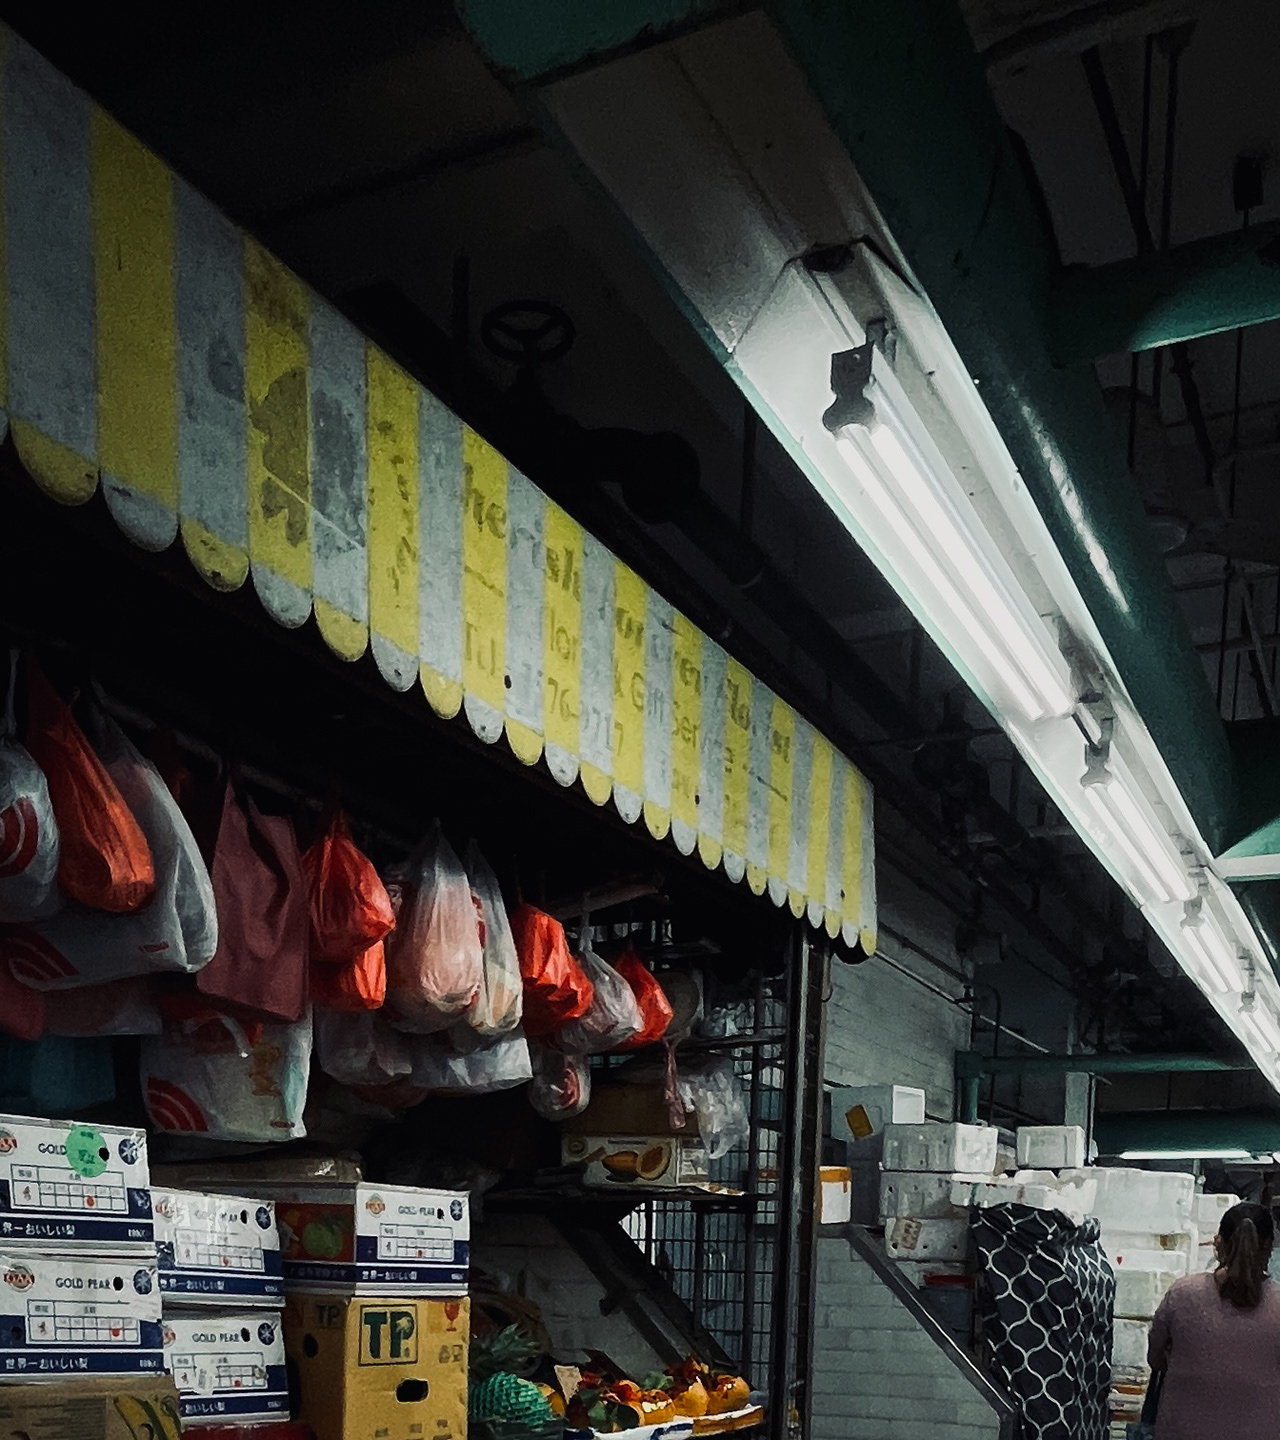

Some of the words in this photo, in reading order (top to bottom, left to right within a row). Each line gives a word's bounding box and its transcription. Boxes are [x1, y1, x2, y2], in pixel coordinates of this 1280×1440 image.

[55, 1277, 84, 1289] GOLD
[87, 1278, 111, 1290] PEAR
[364, 1311, 415, 1359] TP
